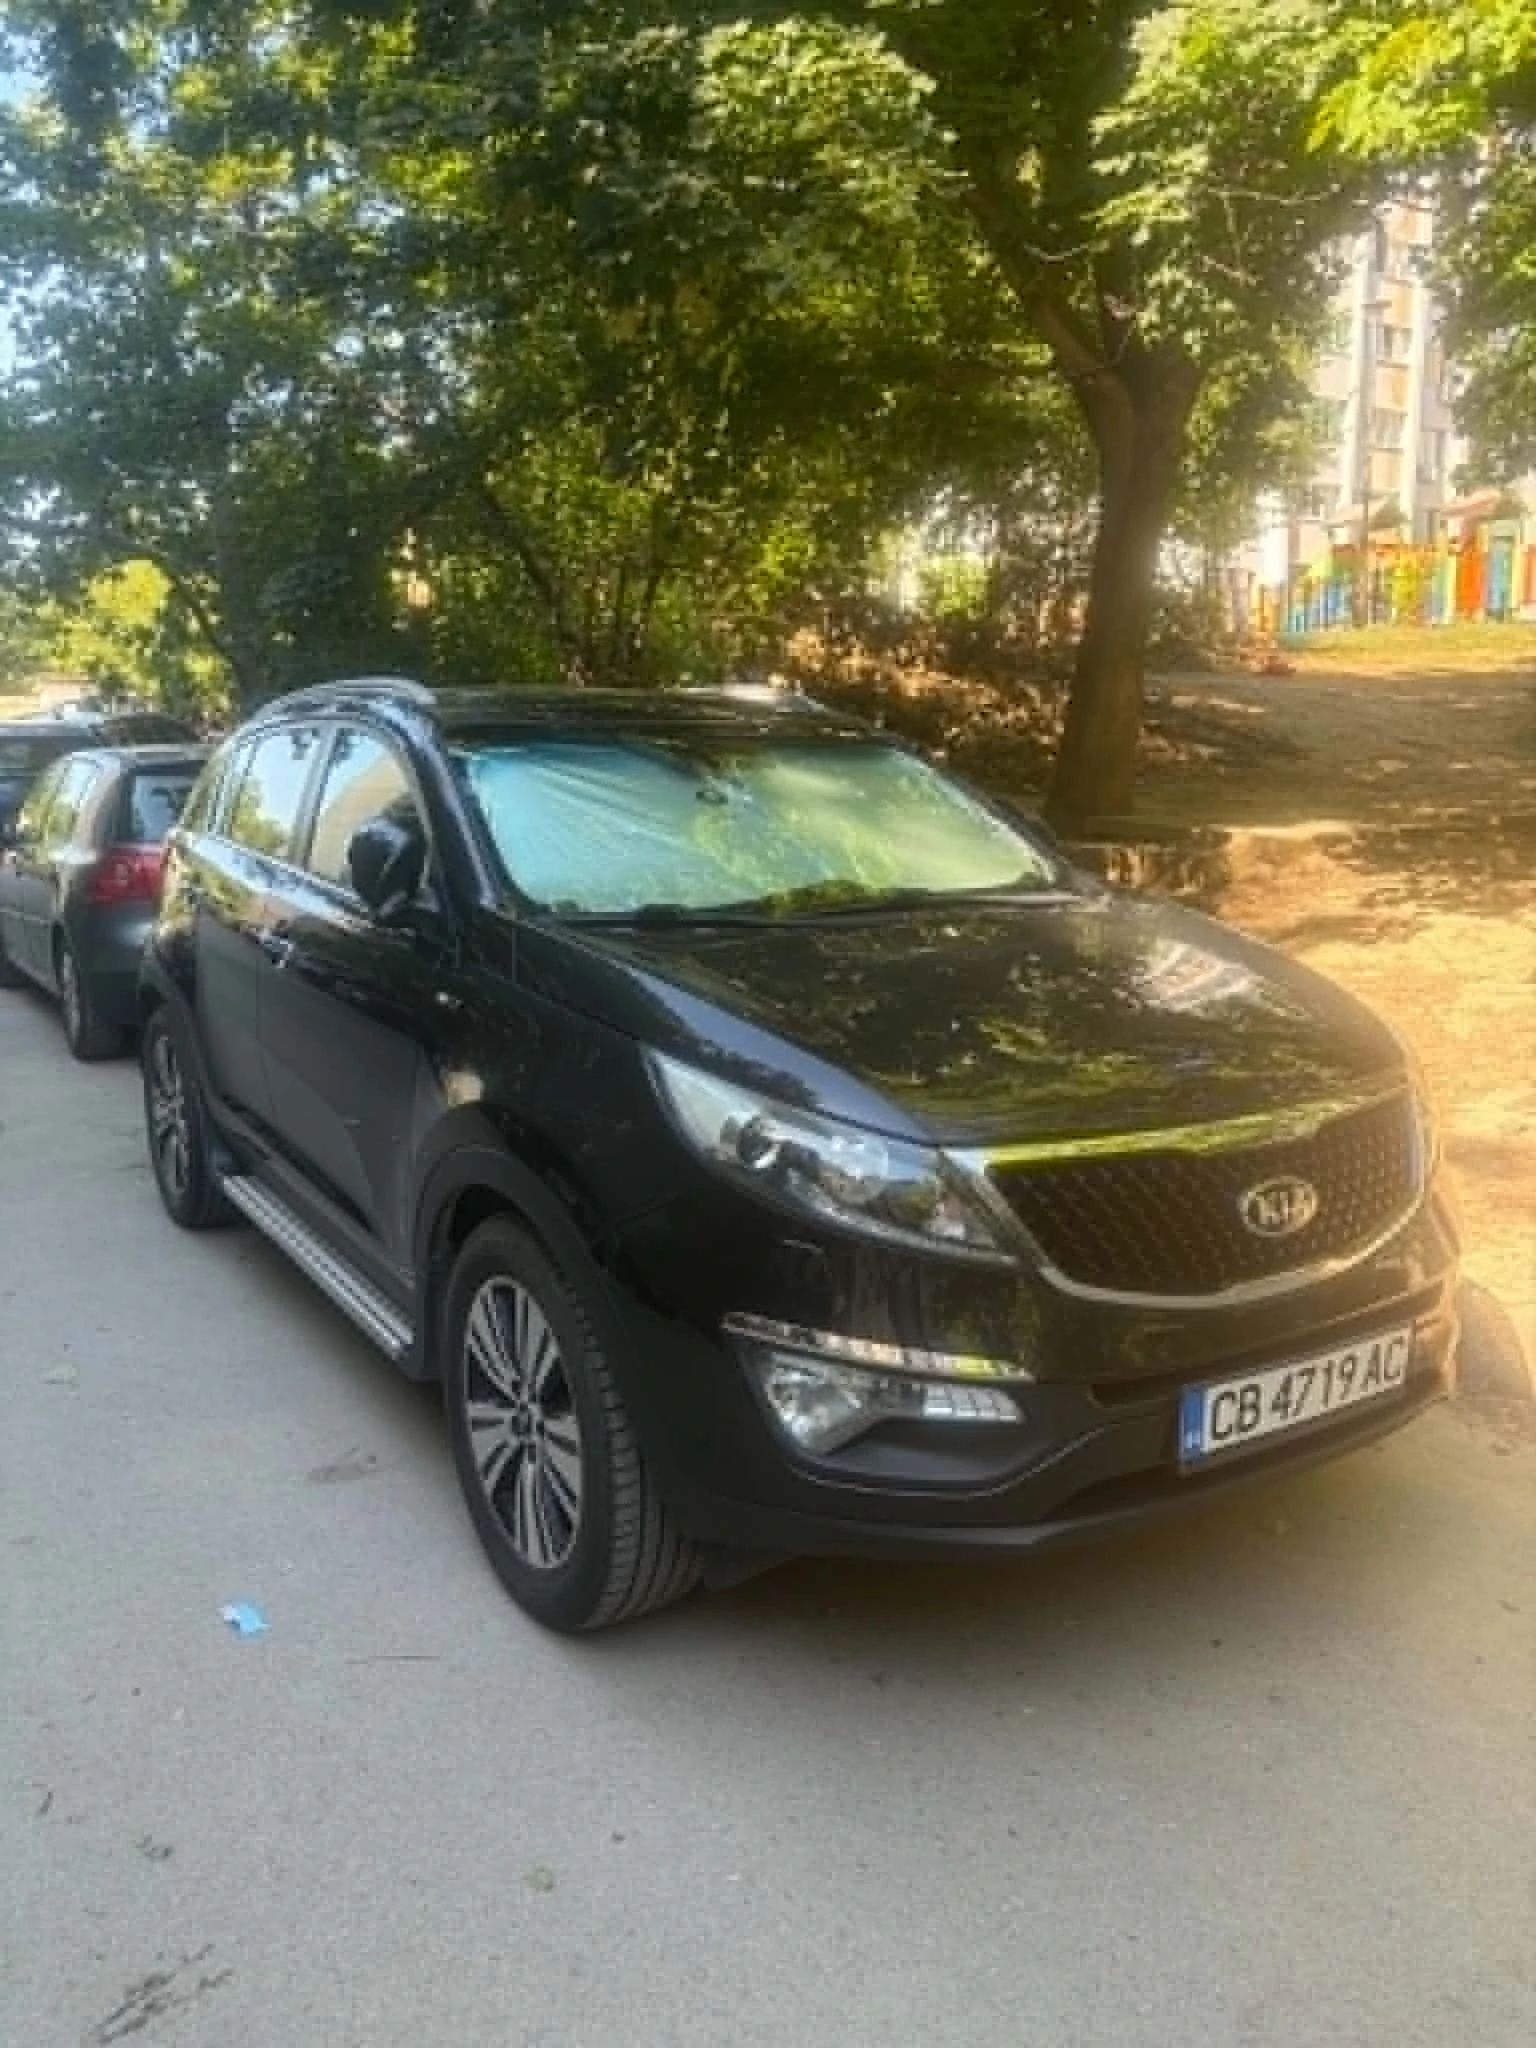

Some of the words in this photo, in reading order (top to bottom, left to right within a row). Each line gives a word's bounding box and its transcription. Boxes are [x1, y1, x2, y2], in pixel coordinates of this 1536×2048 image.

[1253, 1184, 1312, 1228] KIA
[1212, 1382, 1263, 1441] CB
[1270, 1353, 1358, 1420] 4719
[1361, 1336, 1405, 1388] AC
